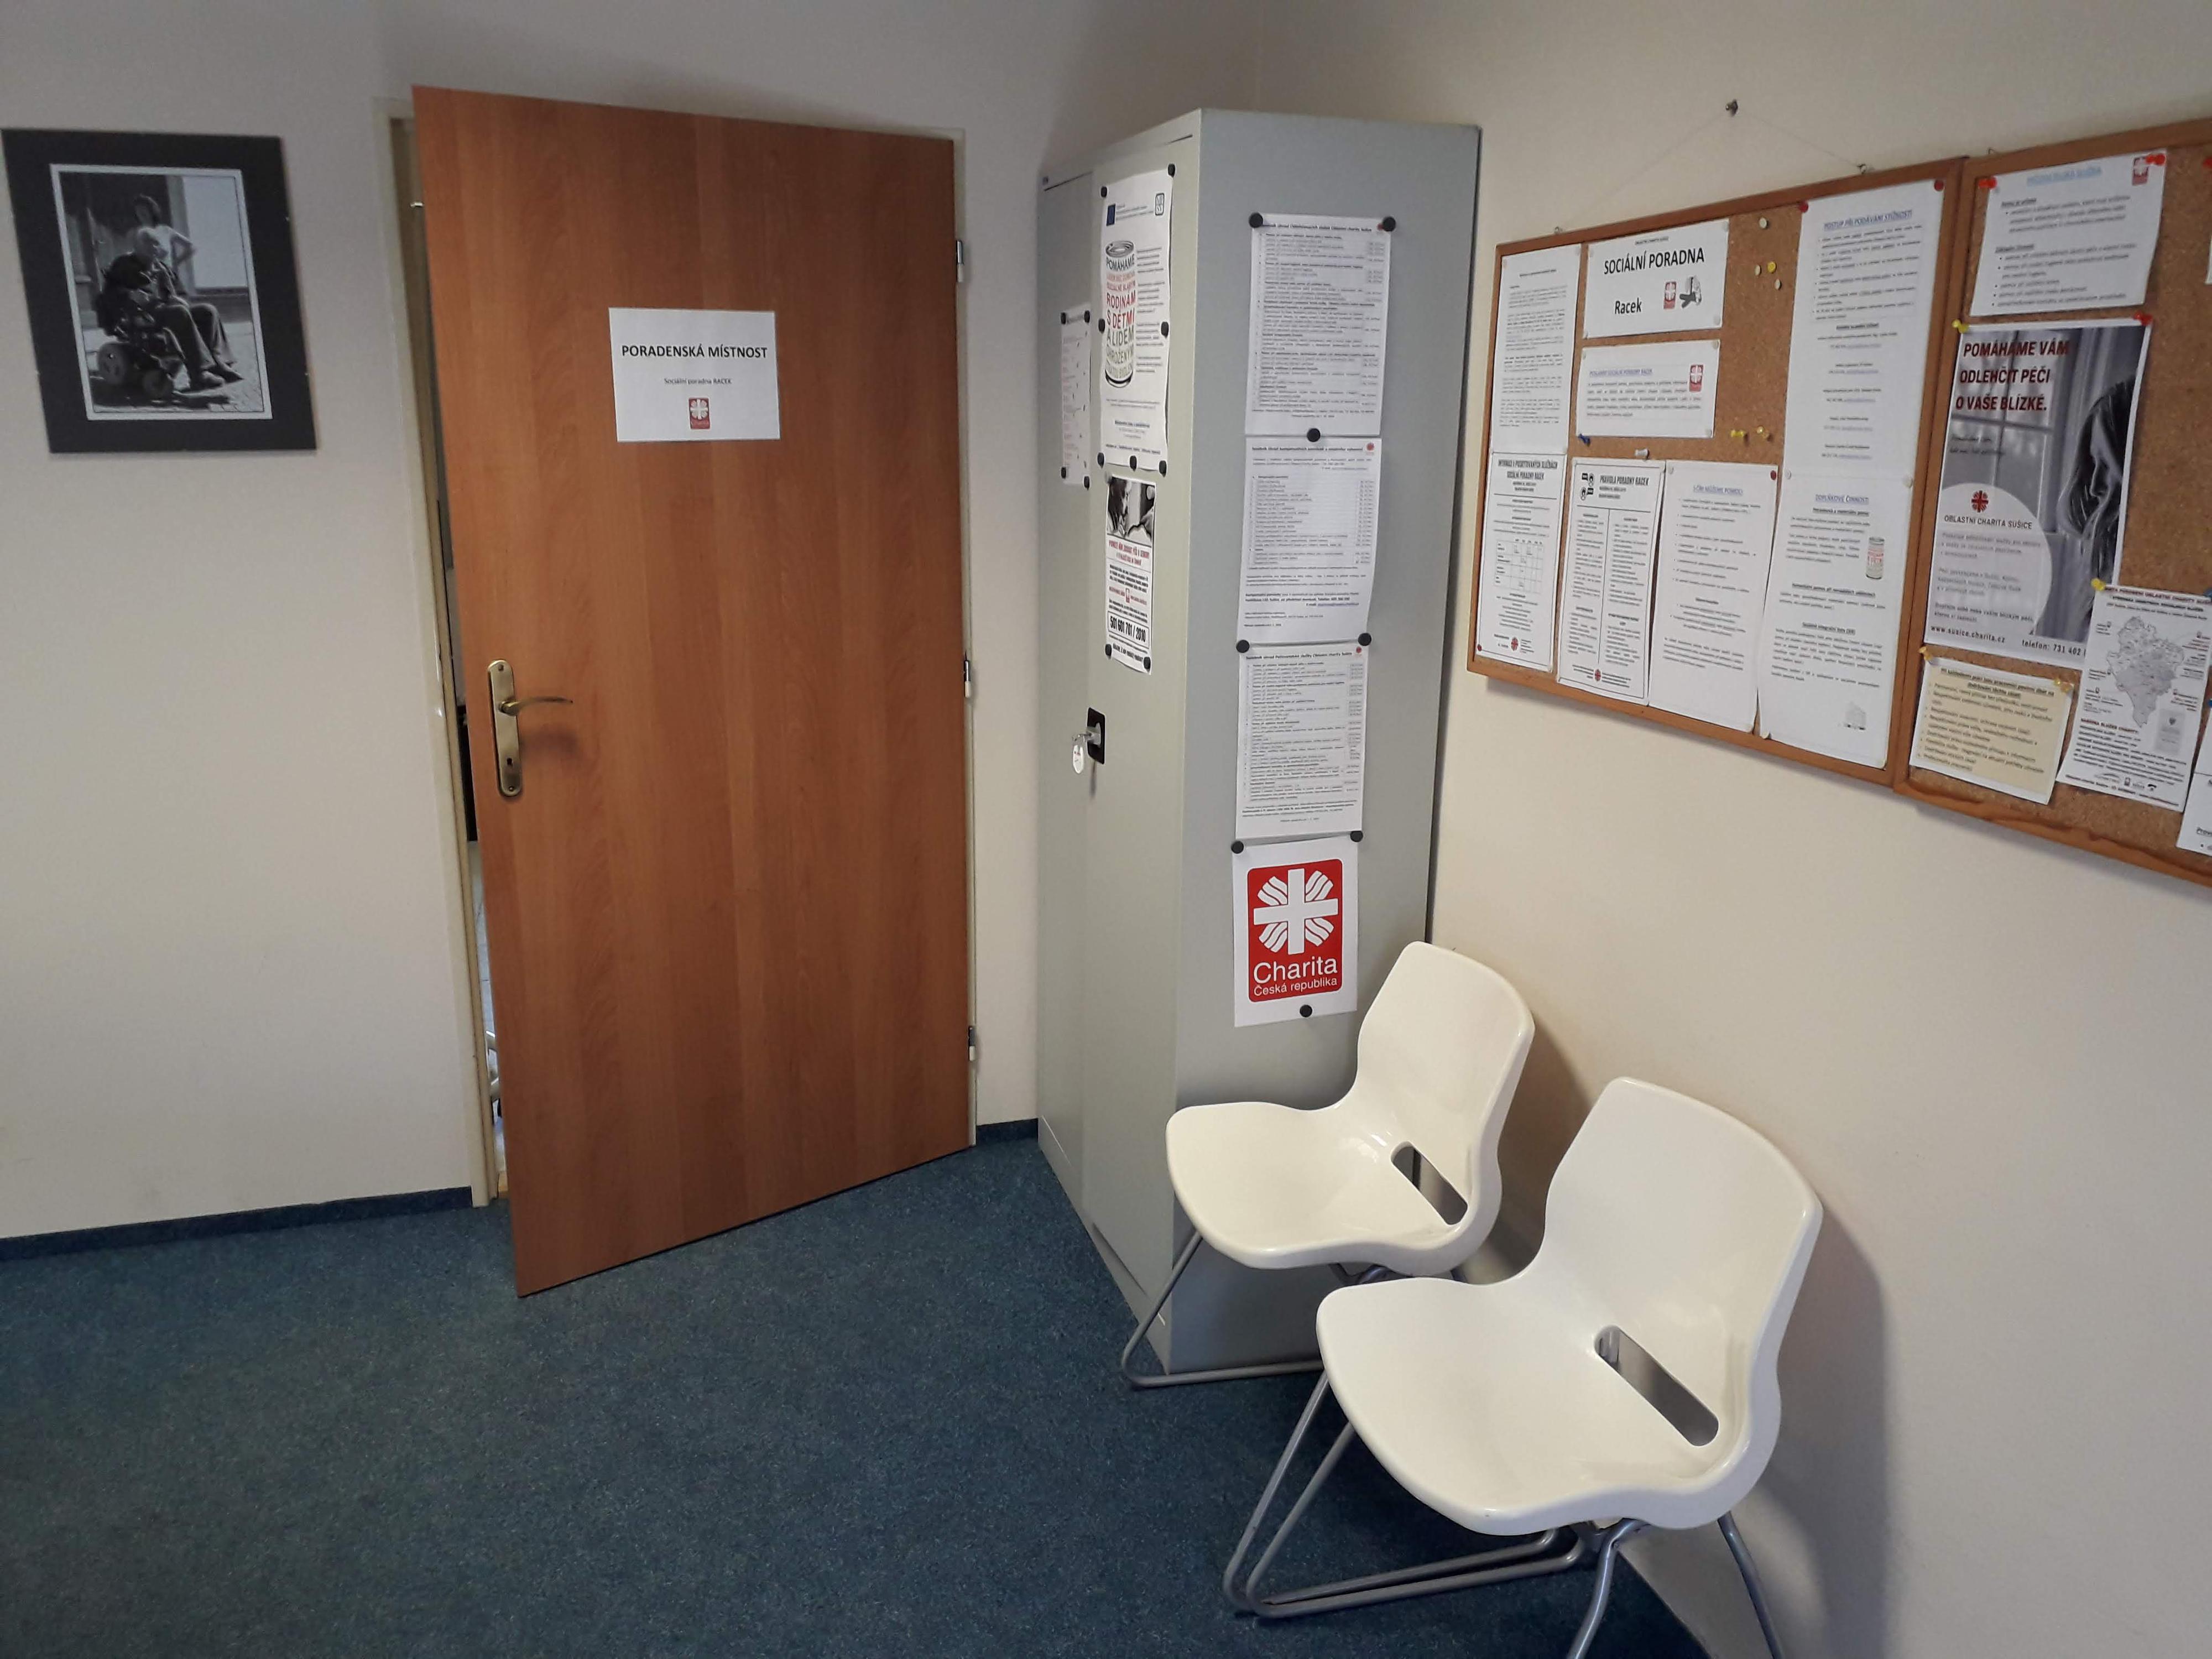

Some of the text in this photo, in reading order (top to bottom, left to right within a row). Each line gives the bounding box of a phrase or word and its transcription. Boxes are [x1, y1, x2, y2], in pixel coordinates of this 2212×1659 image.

[1604, 247, 1704, 275] SOCIÁLNÍ PORADNA
[1614, 297, 1642, 314] Racek
[1107, 310, 1111, 325] S
[622, 343, 768, 358] PORADENSKÁ MÍSTNOST
[2039, 338, 2070, 355] VÁM
[1960, 367, 2018, 383] ODLEHČIT
[1955, 394, 2047, 410] O VAŠE BLÍZKÉ.
[2008, 520, 2032, 529] SUŠICE
[1136, 626, 1146, 643] 2010
[2022, 639, 2050, 651] telefon:
[2053, 644, 2065, 653] 731
[2068, 647, 2081, 656] 402
[1253, 956, 1338, 984] Charita
[1254, 977, 1337, 996] Česká republika
